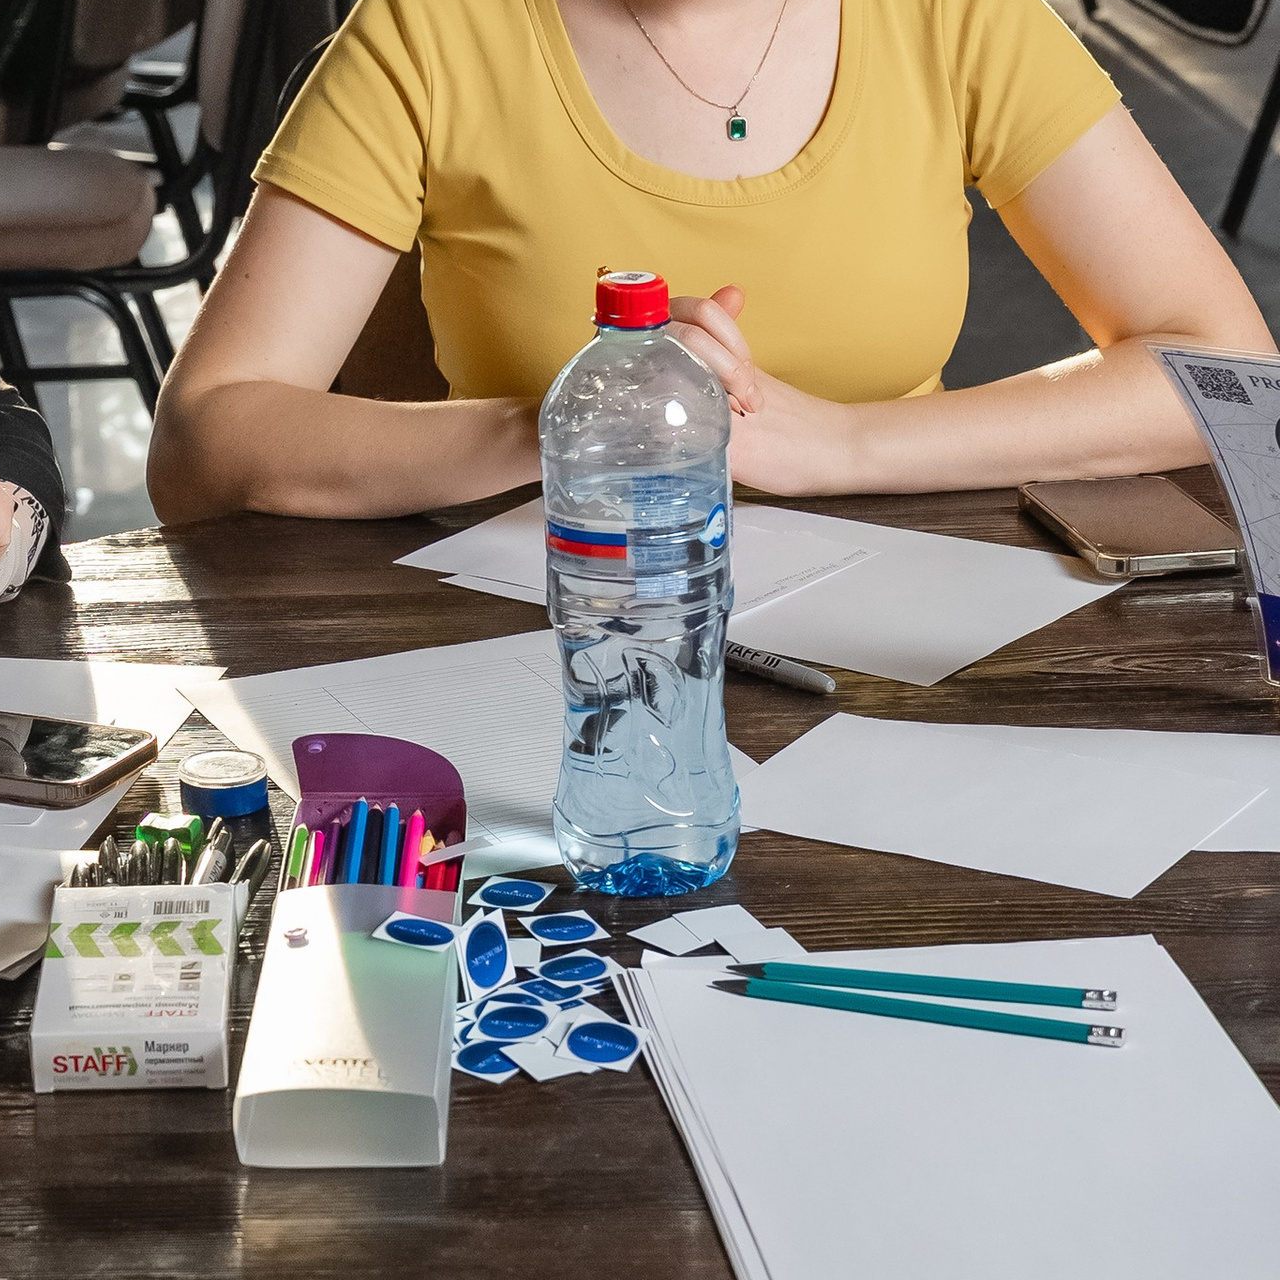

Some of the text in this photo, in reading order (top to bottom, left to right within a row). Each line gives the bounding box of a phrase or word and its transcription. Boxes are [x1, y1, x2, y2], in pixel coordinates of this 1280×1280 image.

[725, 641, 762, 661] TAFF
[145, 1009, 199, 1018] STAFF
[144, 1040, 190, 1054] Маркер
[52, 1054, 128, 1074] STAFF
